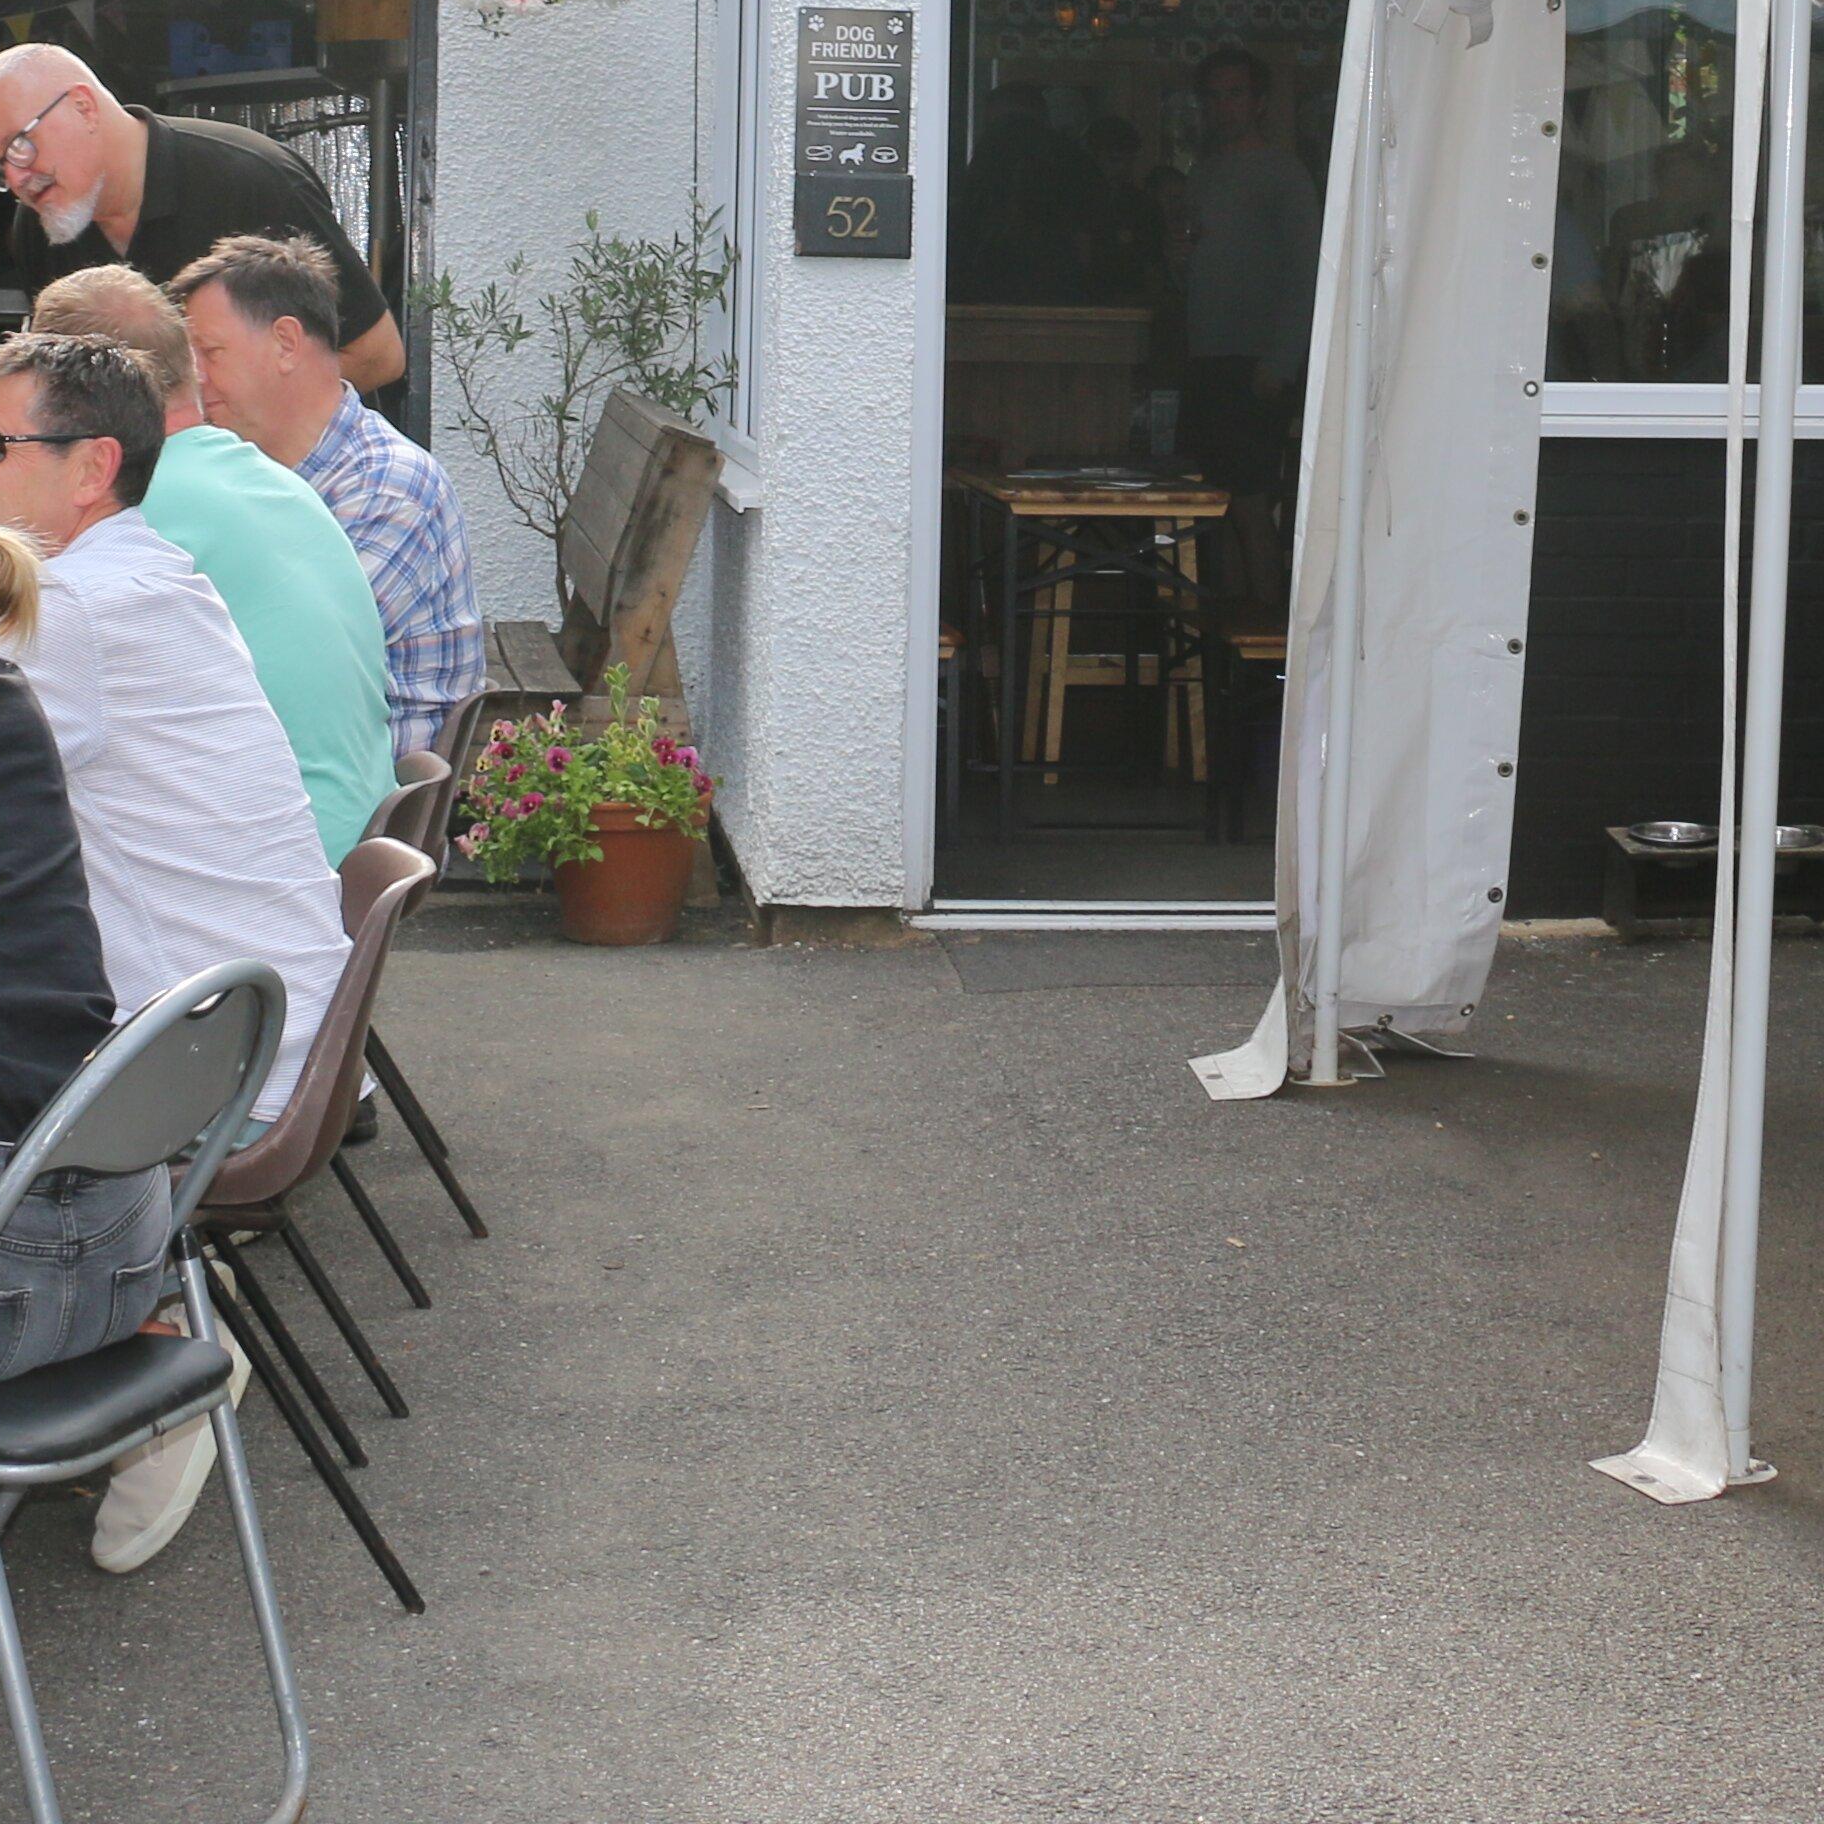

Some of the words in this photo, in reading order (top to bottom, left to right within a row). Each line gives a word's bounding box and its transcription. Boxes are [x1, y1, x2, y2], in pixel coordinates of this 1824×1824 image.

[836, 26, 875, 42] DOG
[811, 42, 899, 60] FRIENDLY
[813, 72, 895, 102] PUB
[827, 196, 879, 238] 52
